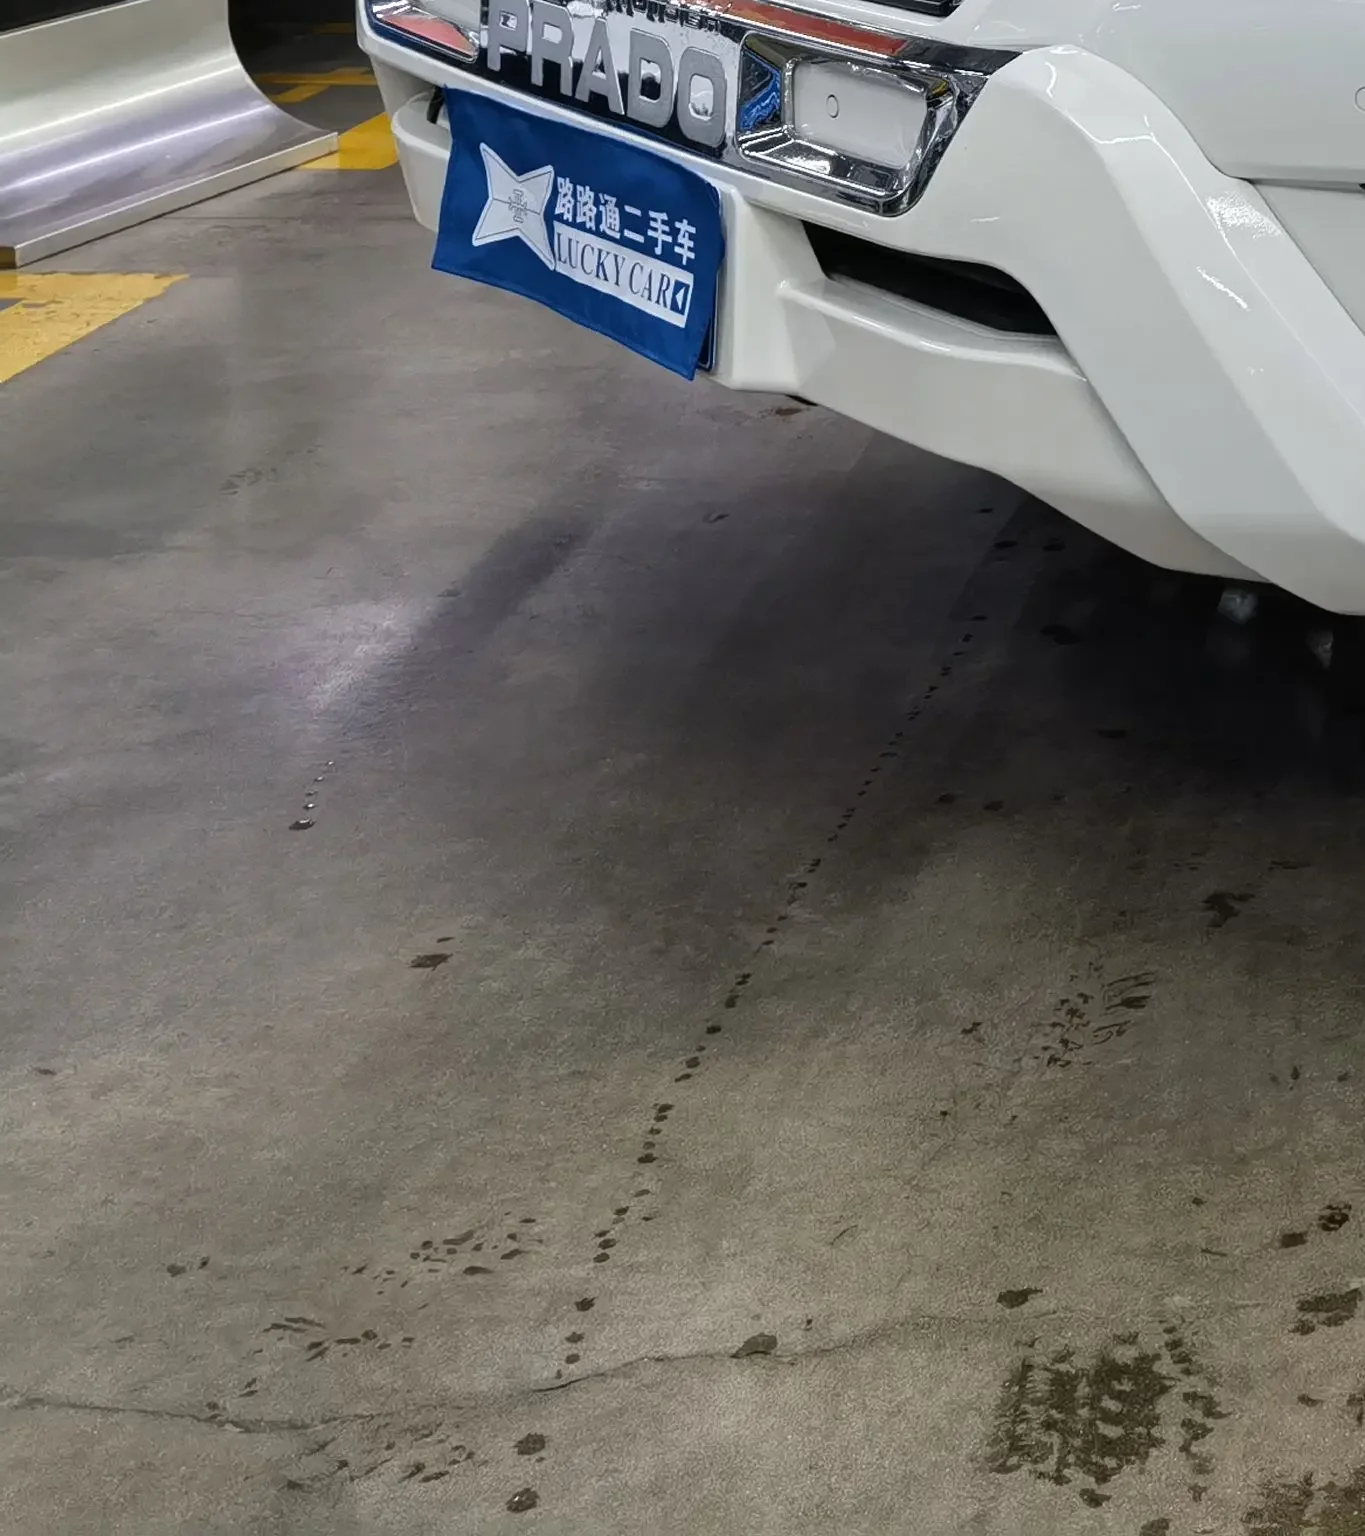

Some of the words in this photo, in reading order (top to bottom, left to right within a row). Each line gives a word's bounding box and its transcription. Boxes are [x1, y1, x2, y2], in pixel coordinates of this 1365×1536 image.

[554, 176, 697, 266] 路路通二手车
[556, 232, 626, 287] LUCKY
[628, 262, 672, 309] CAR
